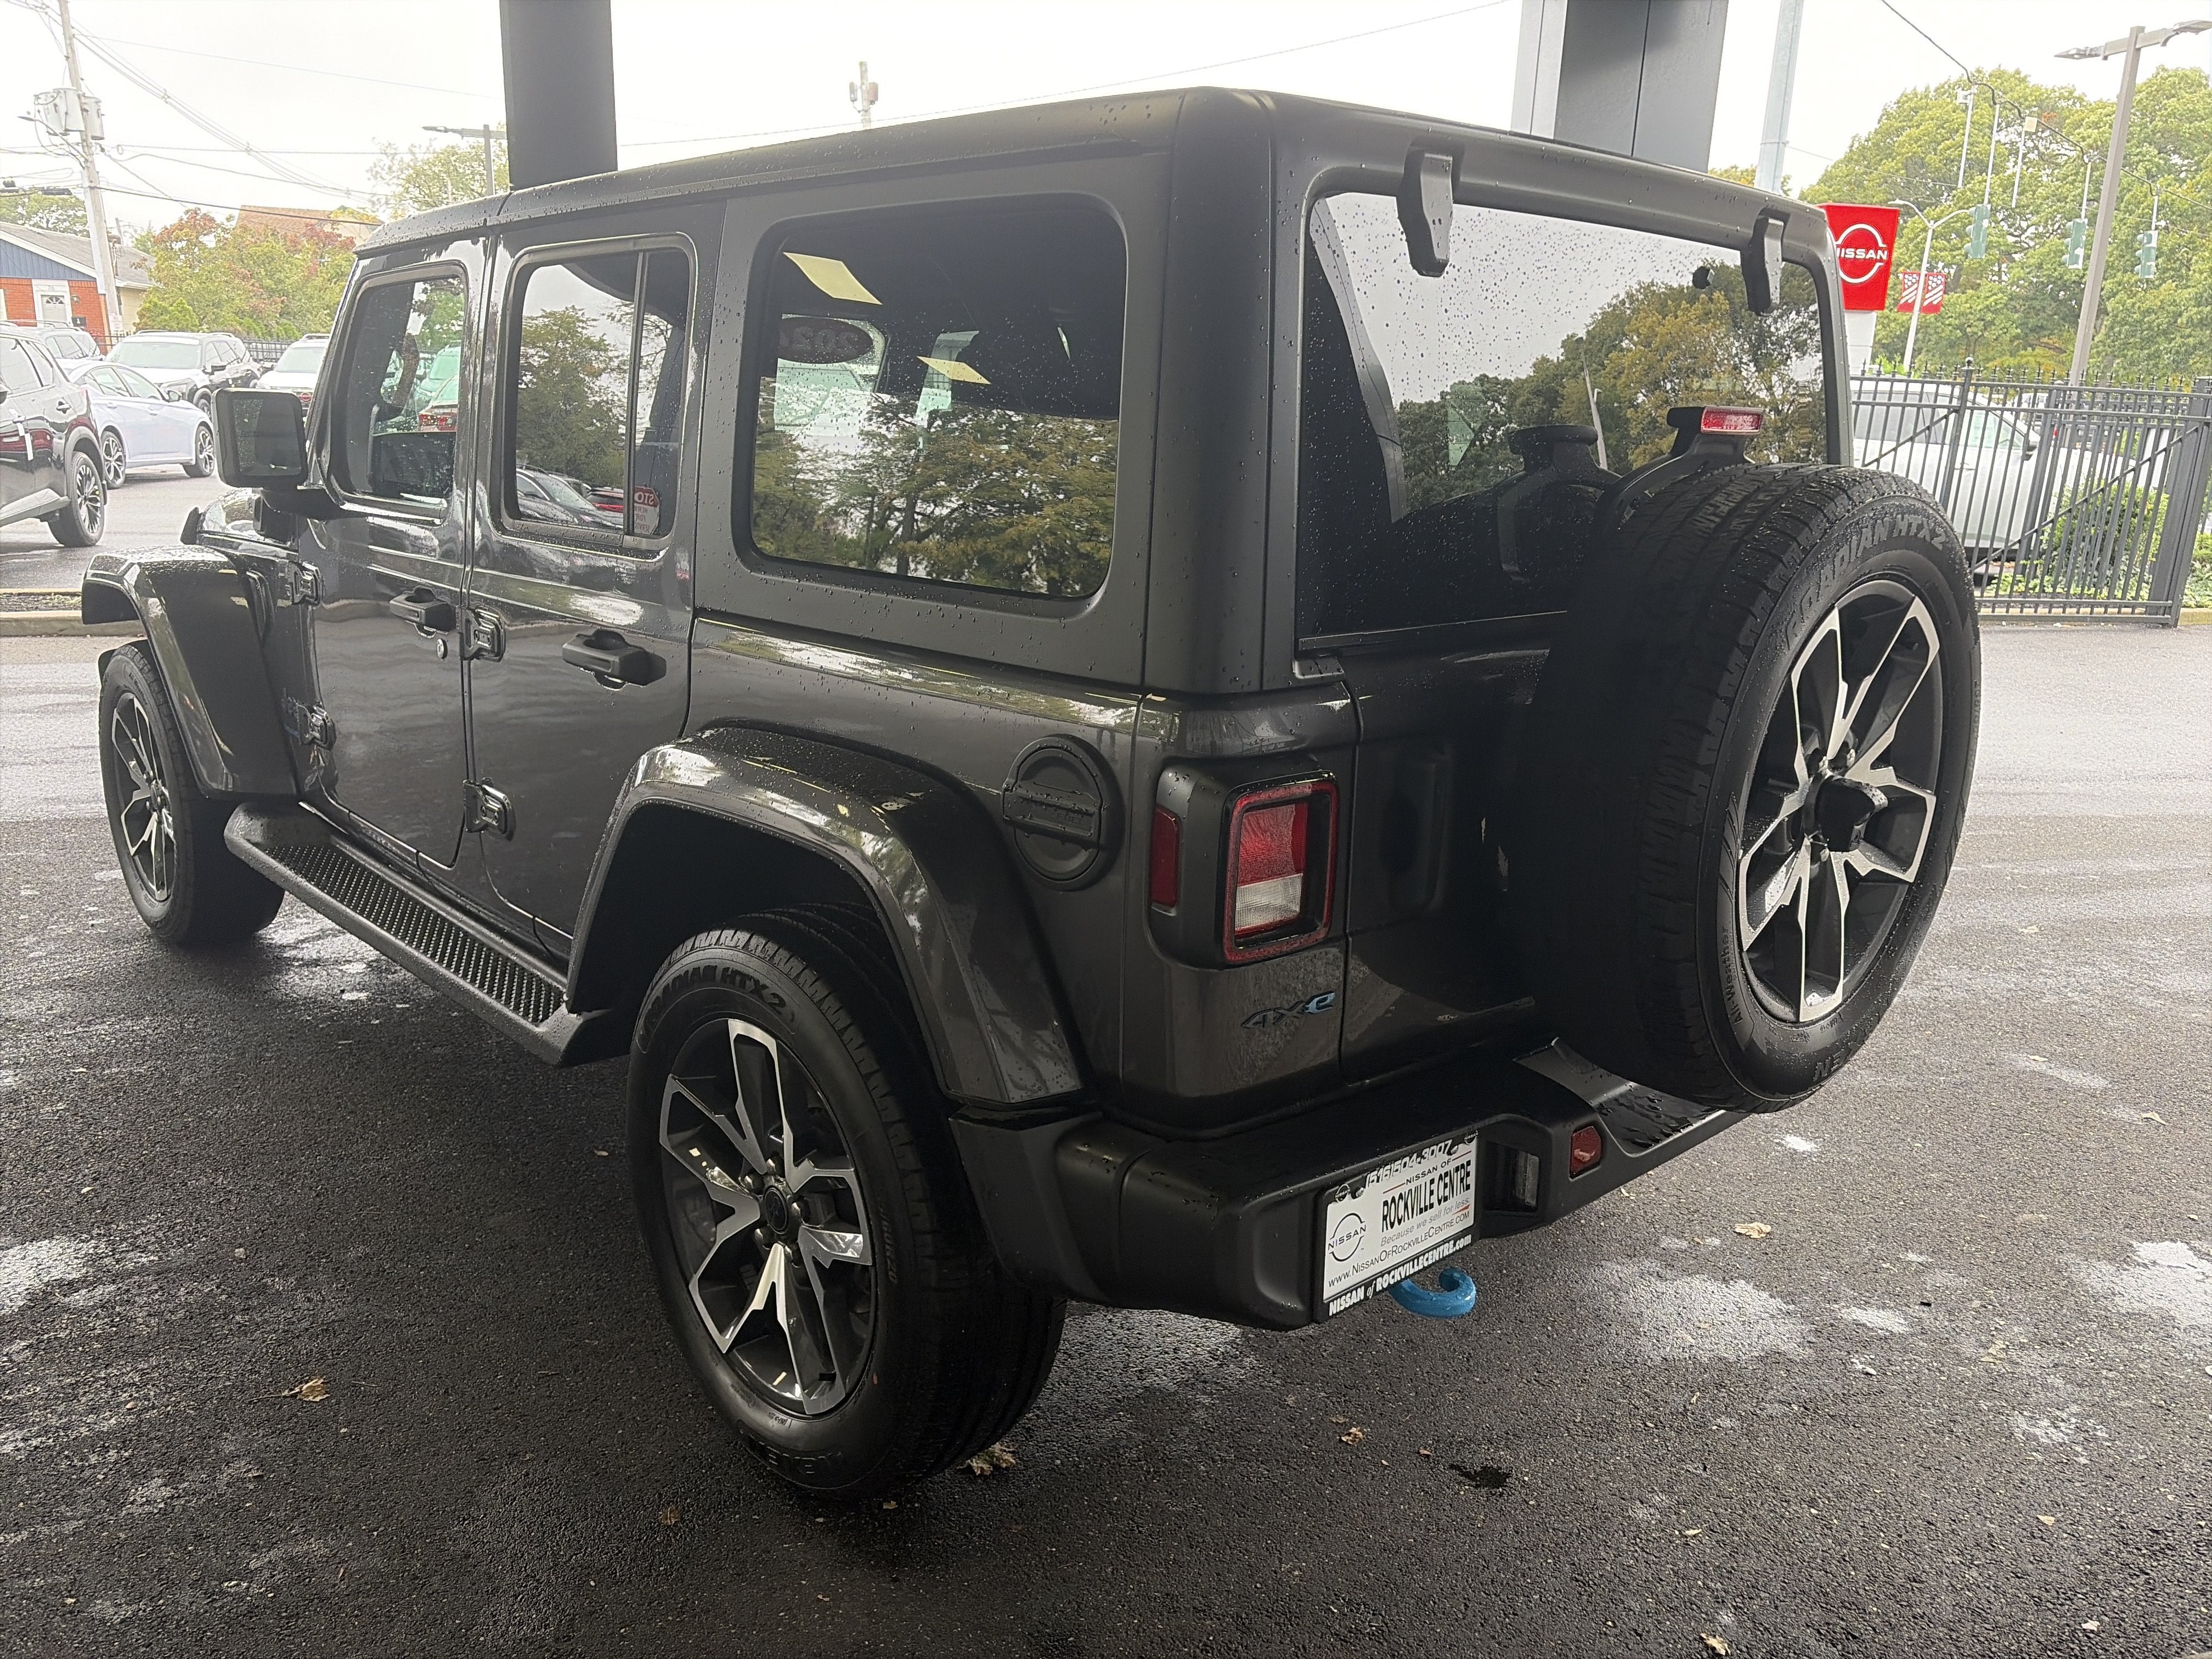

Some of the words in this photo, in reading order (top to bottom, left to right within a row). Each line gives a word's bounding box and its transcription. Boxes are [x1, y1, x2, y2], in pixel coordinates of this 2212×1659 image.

[1406, 1165, 1438, 1186] NISSAN
[1441, 1158, 1452, 1169] OF
[1381, 1177, 1435, 1233] ROCKVILLE
[1437, 1159, 1471, 1206] CENTRE
[1328, 1224, 1367, 1251] NISSAN
[1380, 1223, 1415, 1248] Because
[1417, 1219, 1427, 1231] we
[1429, 1209, 1442, 1226] sell
[1442, 1205, 1453, 1220] for
[1455, 1197, 1470, 1214] less.
[1328, 1285, 1364, 1317] NISSAN
[1366, 1280, 1375, 1299] of
